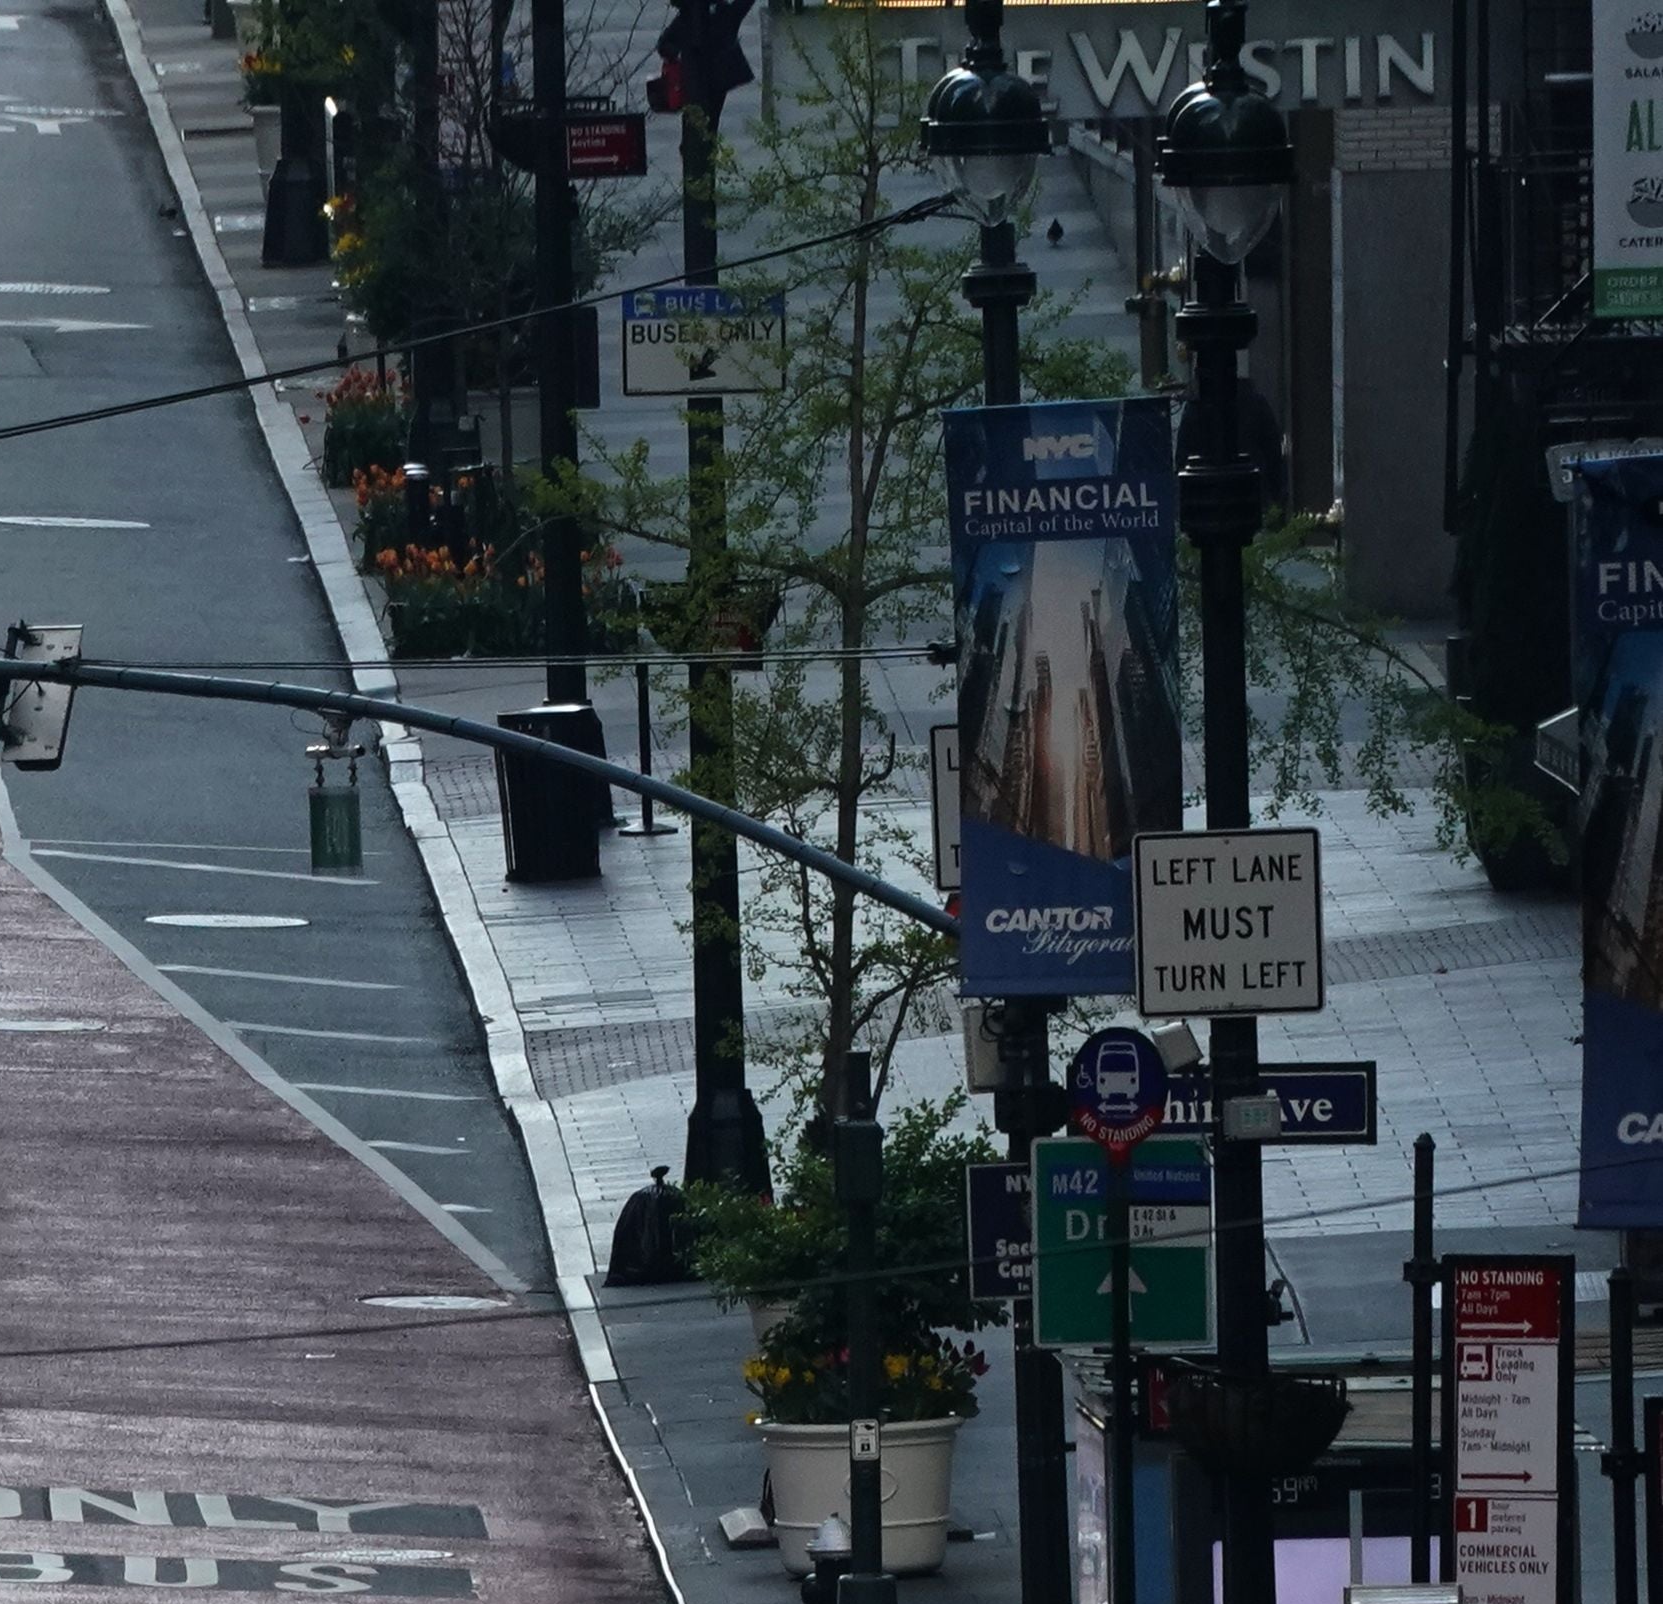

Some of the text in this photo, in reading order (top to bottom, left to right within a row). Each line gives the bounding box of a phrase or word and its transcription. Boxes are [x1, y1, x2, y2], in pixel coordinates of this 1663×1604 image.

[896, 35, 1058, 110] TE
[665, 293, 706, 311] BUS
[631, 321, 710, 344] BUSE
[1023, 433, 1095, 461] NYC
[964, 483, 1159, 516] FINANCIAL
[965, 509, 1160, 540] Capital of the World
[1153, 855, 1302, 885] LEFT LANE
[985, 906, 1114, 935] CANTOR
[1184, 905, 1274, 941] MUST
[1155, 961, 1306, 991] TURN LEFT
[1078, 1112, 1155, 1144] NO STANDING
[1052, 1169, 1099, 1195] M42
[1142, 1209, 1154, 1220] 42
[1065, 1209, 1109, 1240] Dr
[1133, 1225, 1140, 1237] 3
[1460, 1271, 1544, 1285] NO STANDING
[1461, 1289, 1481, 1298] 7am
[1491, 1289, 1510, 1302] 7pm
[1461, 1303, 1498, 1317] All Days
[1496, 1347, 1524, 1357] Truck
[1495, 1359, 1535, 1371] Loading
[1495, 1372, 1518, 1384] Only
[1461, 1394, 1501, 1406] Midnight
[1512, 1394, 1531, 1404] 7am
[1461, 1407, 1498, 1421] All Days
[1461, 1427, 1496, 1440] Sunday
[1461, 1441, 1481, 1452] 7am
[1490, 1440, 1530, 1453] Midnight
[1467, 1501, 1477, 1529] 1
[1459, 1544, 1537, 1558] COMMERCIAL
[1459, 1561, 1549, 1575] VEHICLES ONLY
